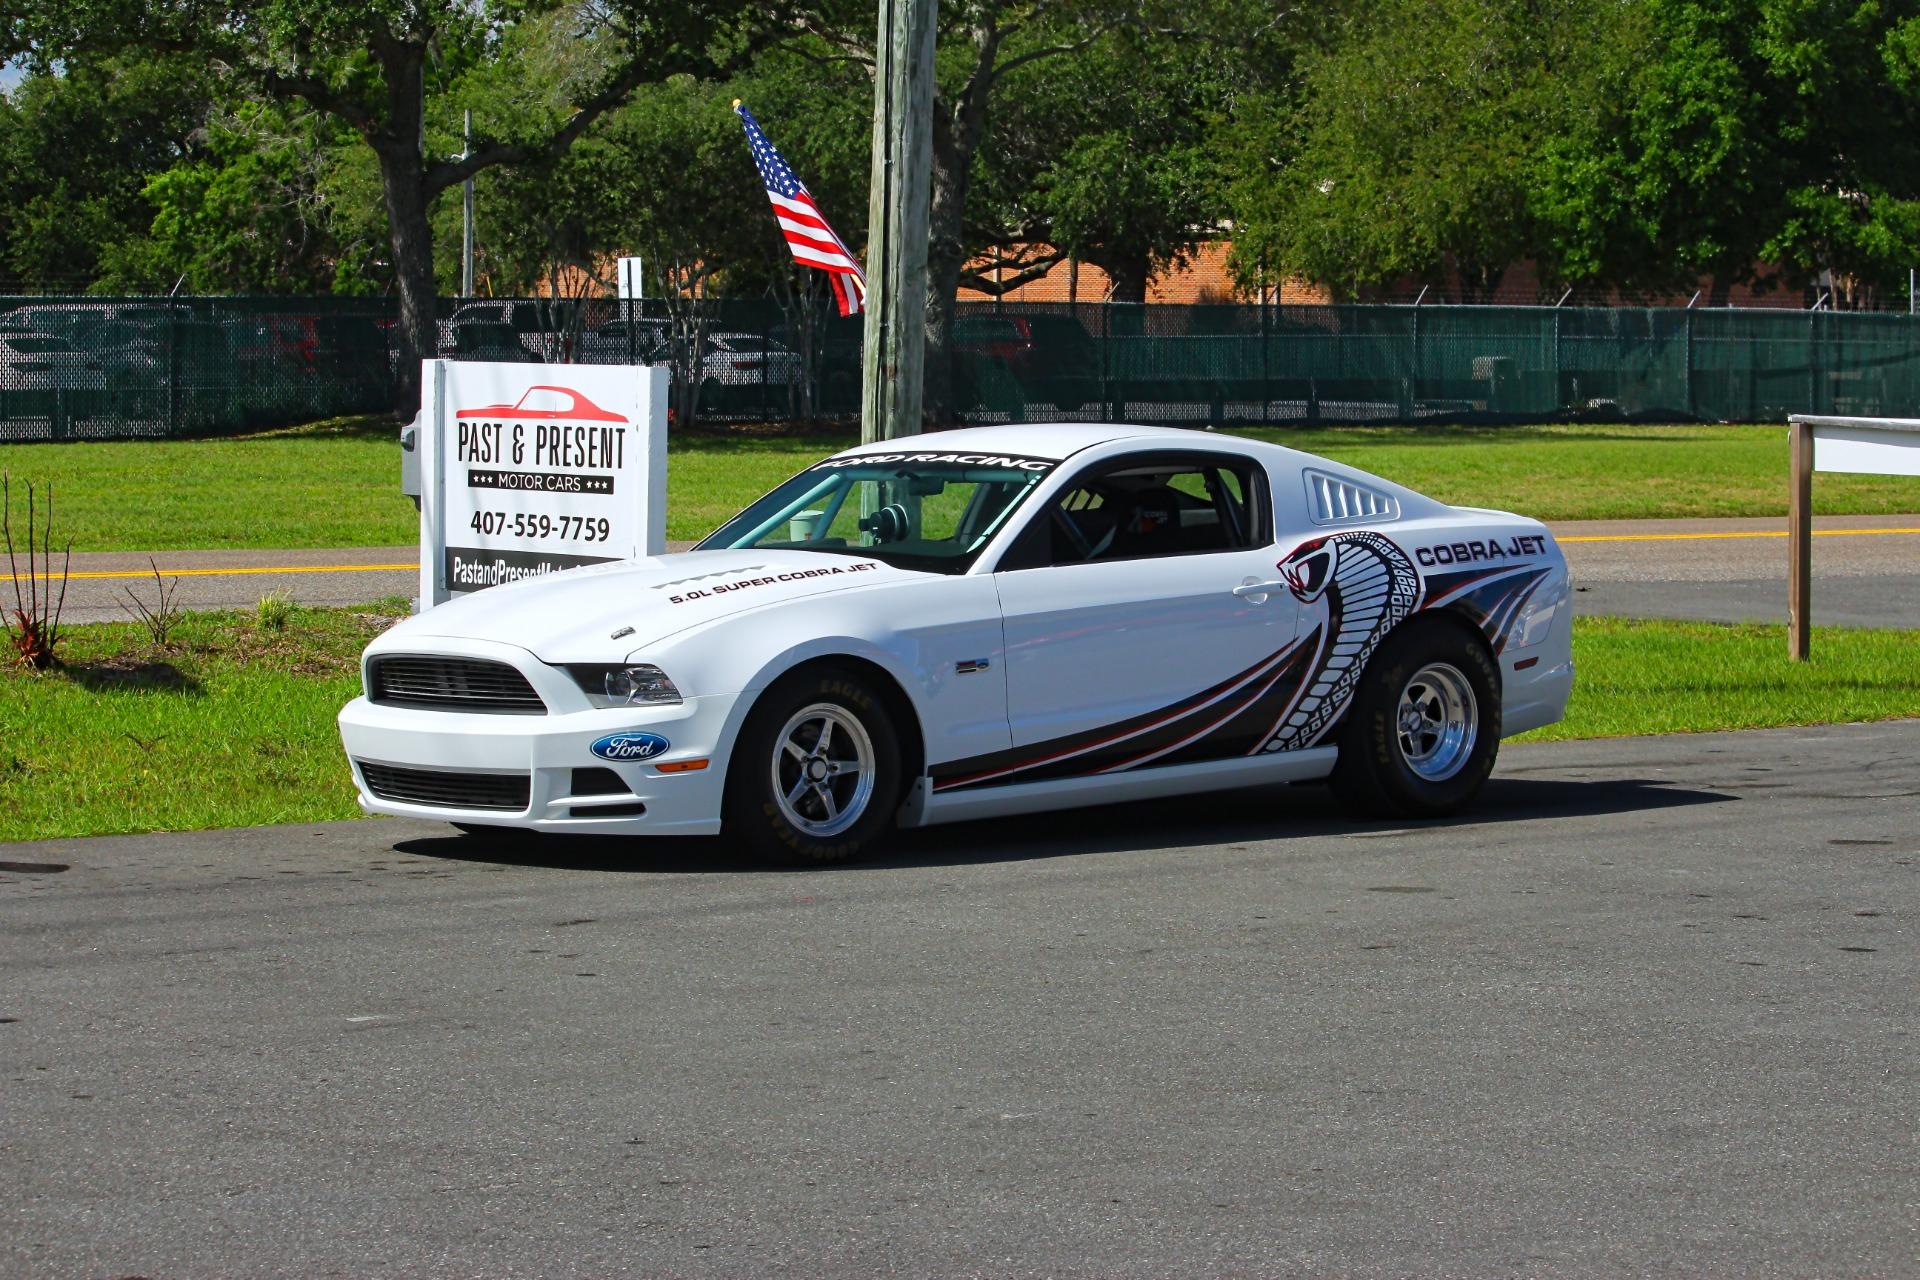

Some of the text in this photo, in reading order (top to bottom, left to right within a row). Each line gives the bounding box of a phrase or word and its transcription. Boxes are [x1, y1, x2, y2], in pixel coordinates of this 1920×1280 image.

[458, 422, 626, 469] PAST & PRESENT
[810, 453, 1054, 472] FORD RACING
[498, 473, 581, 492] MOTOR CARS
[470, 510, 610, 542] 407-559-7759
[1415, 535, 1547, 567] COBRA JET
[669, 562, 877, 604] 5.0L SUPER COBRA JET
[606, 736, 653, 757] Ford
